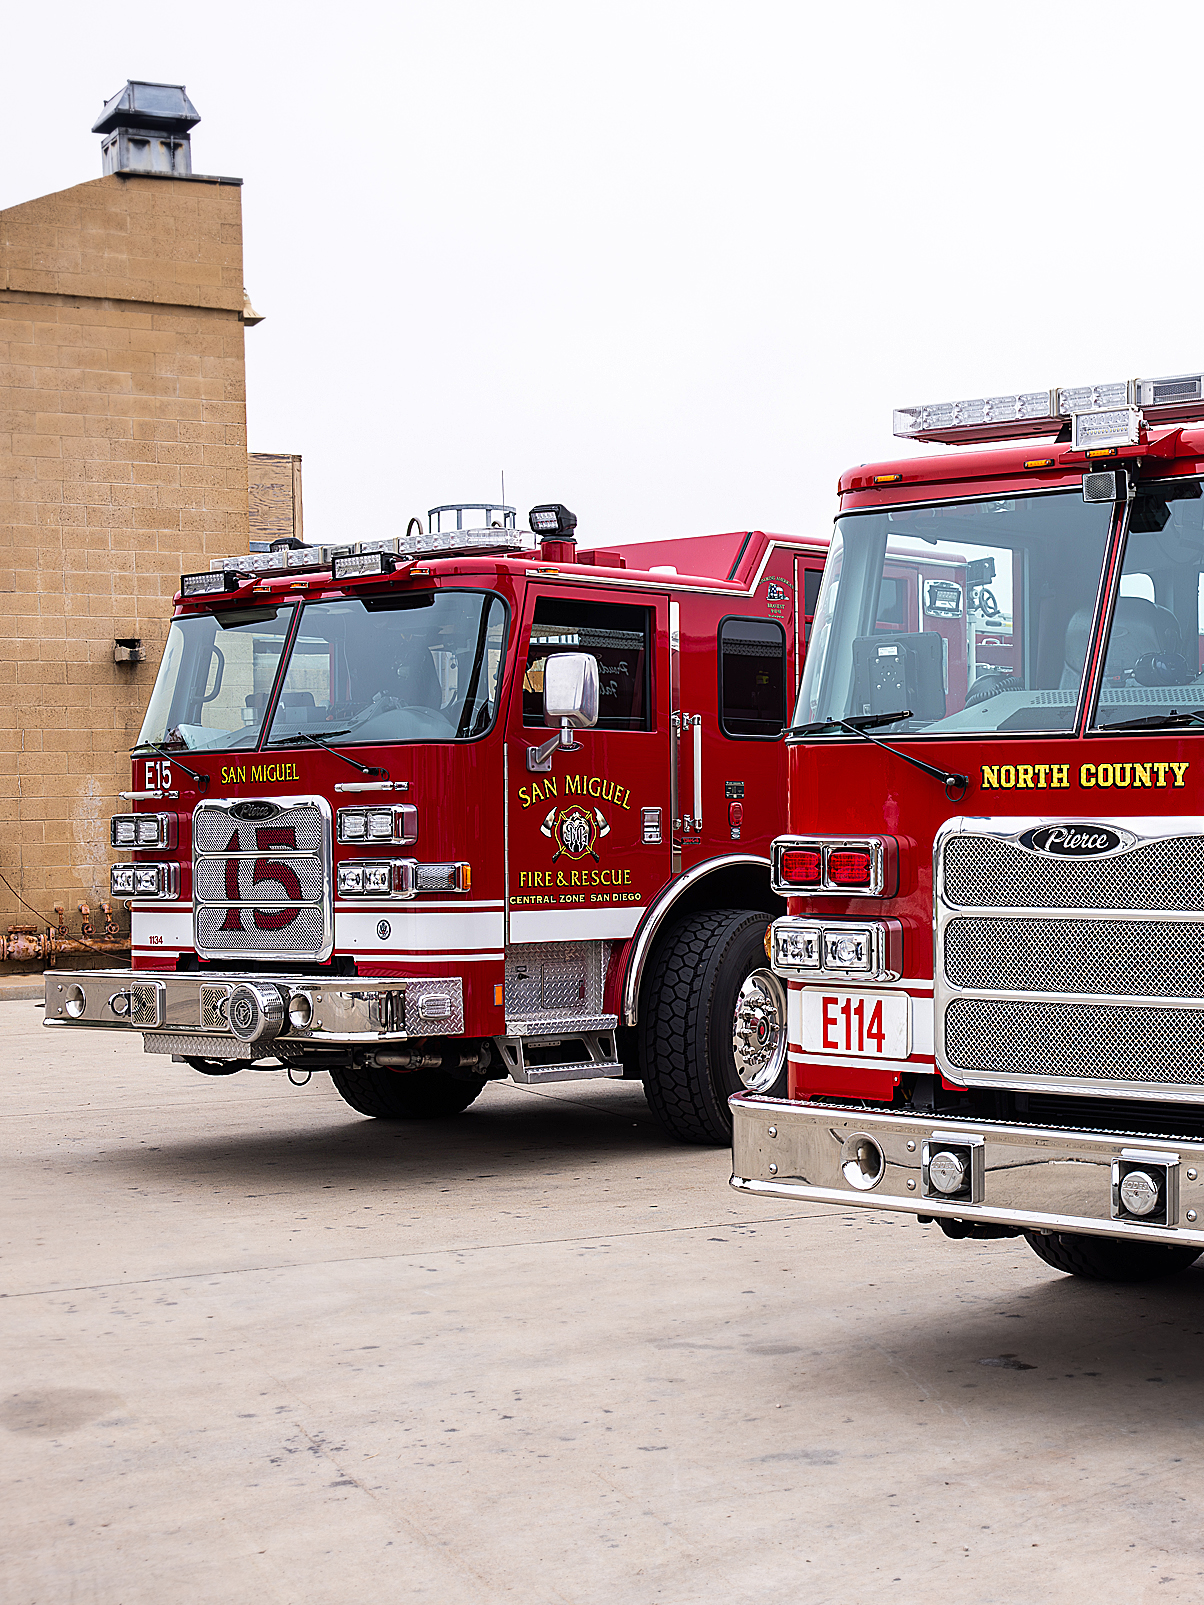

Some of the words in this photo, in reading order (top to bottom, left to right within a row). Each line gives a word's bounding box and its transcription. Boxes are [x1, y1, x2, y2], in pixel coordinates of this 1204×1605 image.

[145, 761, 172, 789] E15
[221, 766, 246, 785] SAN
[251, 763, 300, 783] MIGUEL
[980, 764, 1070, 790] NORTH
[1079, 762, 1190, 790] COUNTY
[518, 776, 558, 809] SAN
[564, 774, 631, 810] MIGUEL
[1043, 827, 1110, 853] Pierce
[216, 826, 303, 932] 15
[519, 871, 554, 887] FIRE
[570, 869, 632, 886] RESCUE
[509, 895, 557, 905] CENTRAL
[558, 894, 586, 904] ZONE
[590, 893, 610, 903] SAN
[612, 892, 642, 902] DIEGO
[149, 935, 164, 945] 1134
[822, 996, 886, 1054] E114
